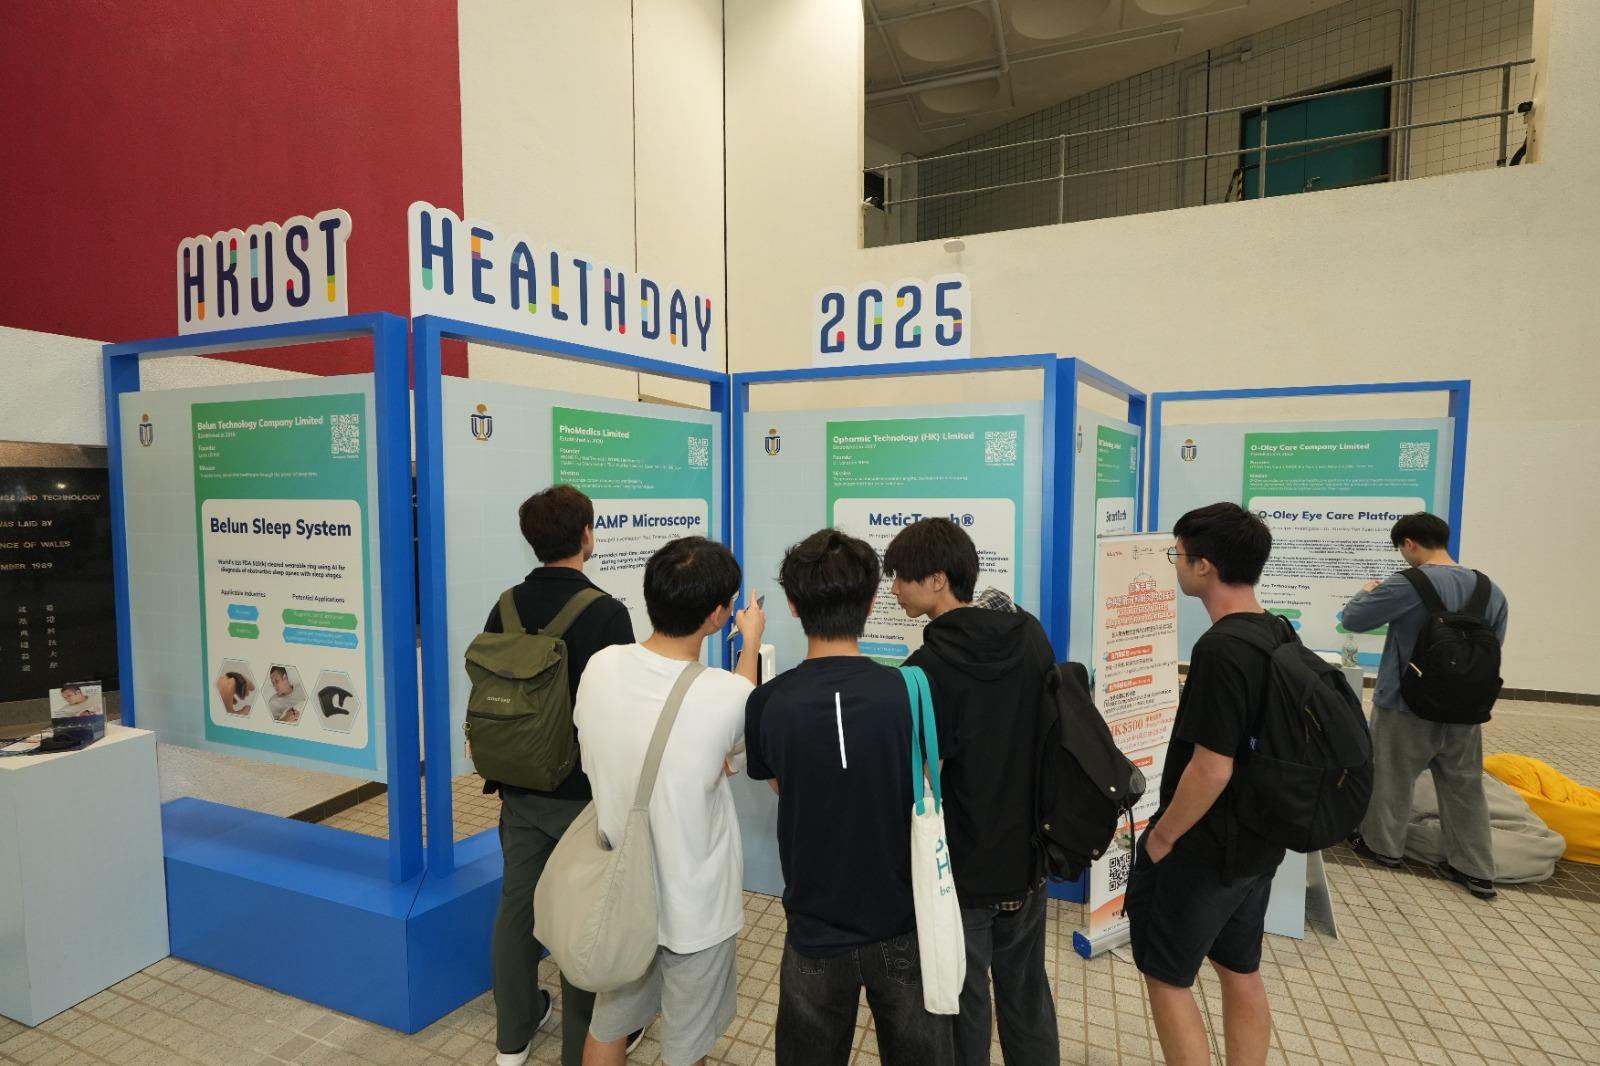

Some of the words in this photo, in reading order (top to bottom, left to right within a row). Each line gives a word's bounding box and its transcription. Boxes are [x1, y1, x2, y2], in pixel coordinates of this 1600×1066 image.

[183, 218, 341, 322] HKUST
[420, 210, 626, 335] HEALTH
[641, 277, 711, 351] DAY
[821, 282, 962, 353] 2025
[198, 422, 216, 430] Belun
[218, 420, 257, 430] Technology
[259, 418, 292, 428] Company
[295, 416, 324, 426] Limited
[560, 425, 601, 436] PhoMedics
[602, 428, 630, 439] Limited
[832, 436, 870, 444] Opharmic
[873, 434, 918, 444] Technology
[920, 433, 940, 442] (HK)
[942, 432, 974, 440] Limited
[1250, 444, 1278, 452] O-Oley
[1299, 444, 1338, 452] Company
[593, 515, 628, 528] AMP
[632, 514, 700, 528] Microscope
[1258, 510, 1298, 521] O-Oley
[1302, 511, 1322, 521] Eye
[1326, 512, 1354, 520] Care
[211, 517, 248, 534] Belun
[252, 518, 292, 539] Sleep
[296, 519, 352, 540] System
[314, 595, 345, 604] Applications
